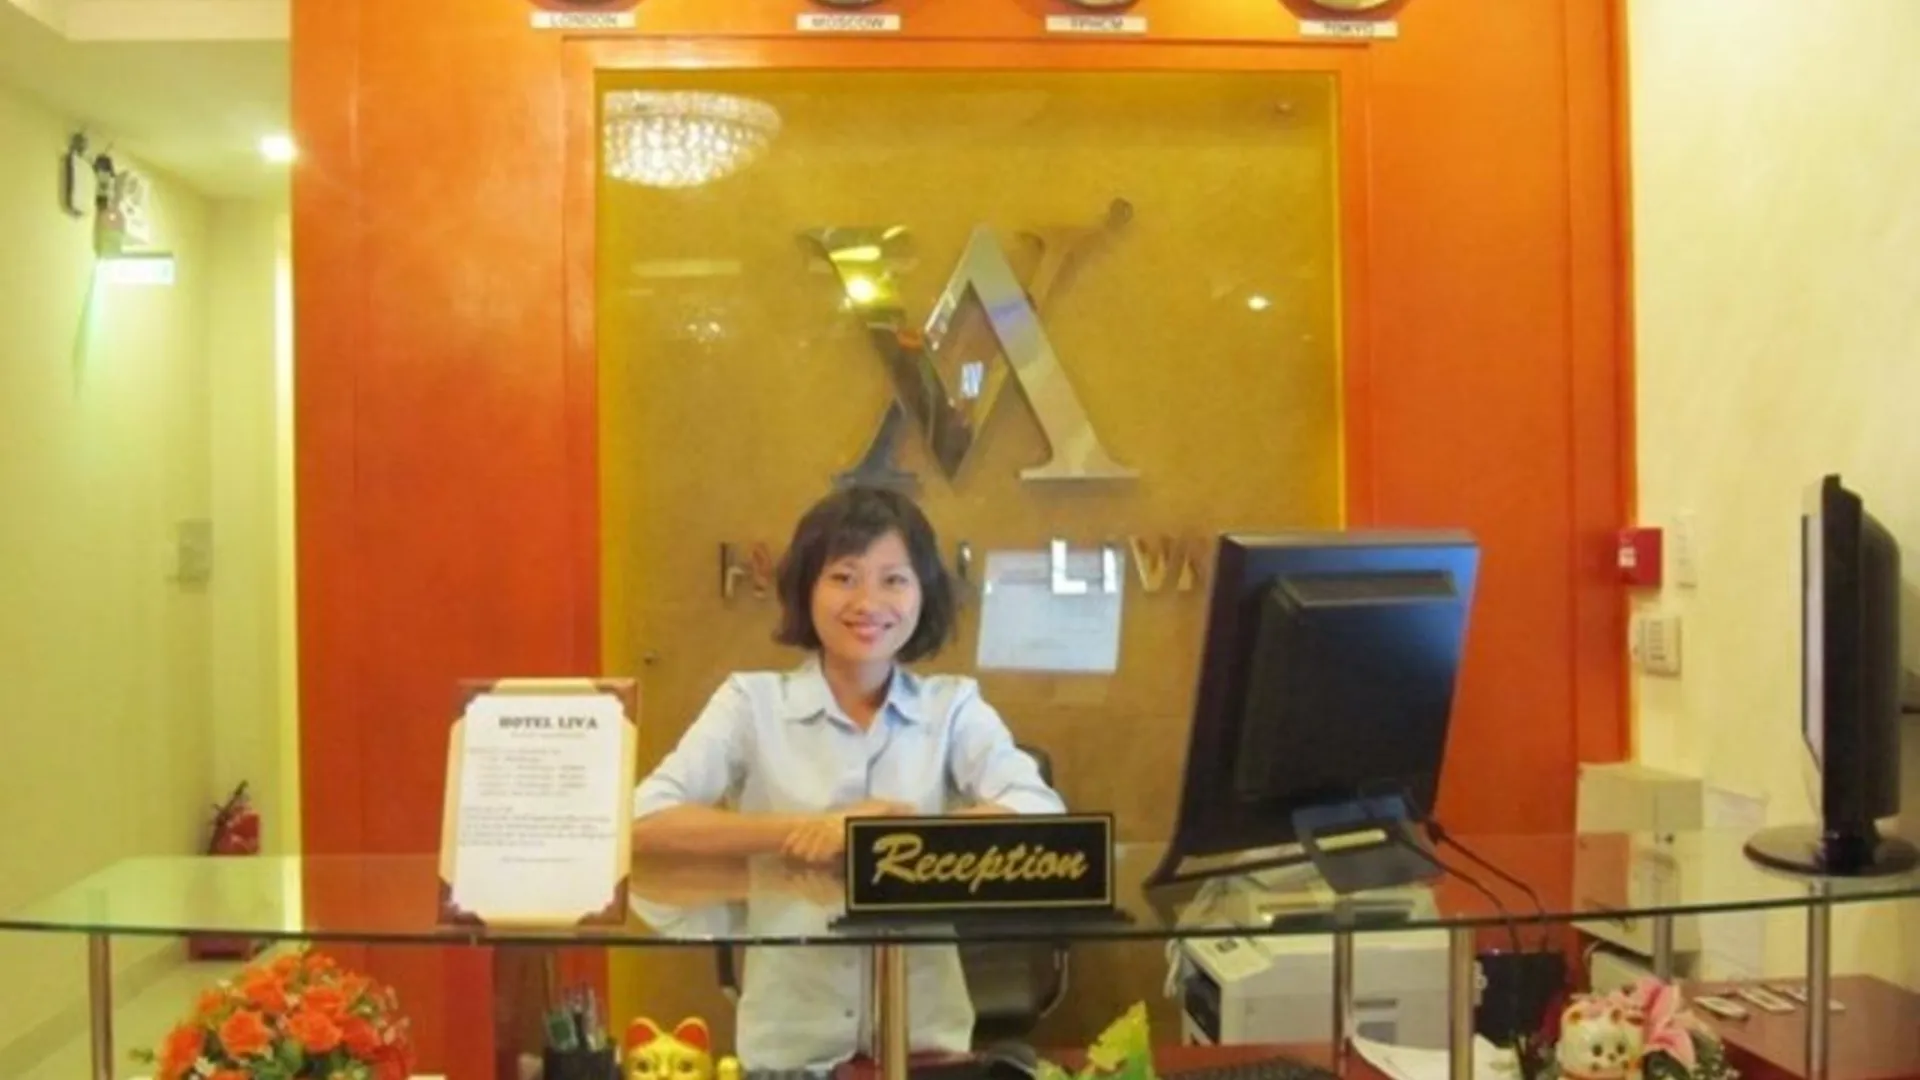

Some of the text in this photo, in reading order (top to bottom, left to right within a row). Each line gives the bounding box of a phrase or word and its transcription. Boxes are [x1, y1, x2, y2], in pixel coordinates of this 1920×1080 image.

[549, 13, 618, 27] LONDON
[811, 15, 885, 29] MOSCOW
[1323, 21, 1375, 36] TOKYO
[499, 716, 599, 730] HOTEL LIVA
[872, 833, 1088, 894] Reception
